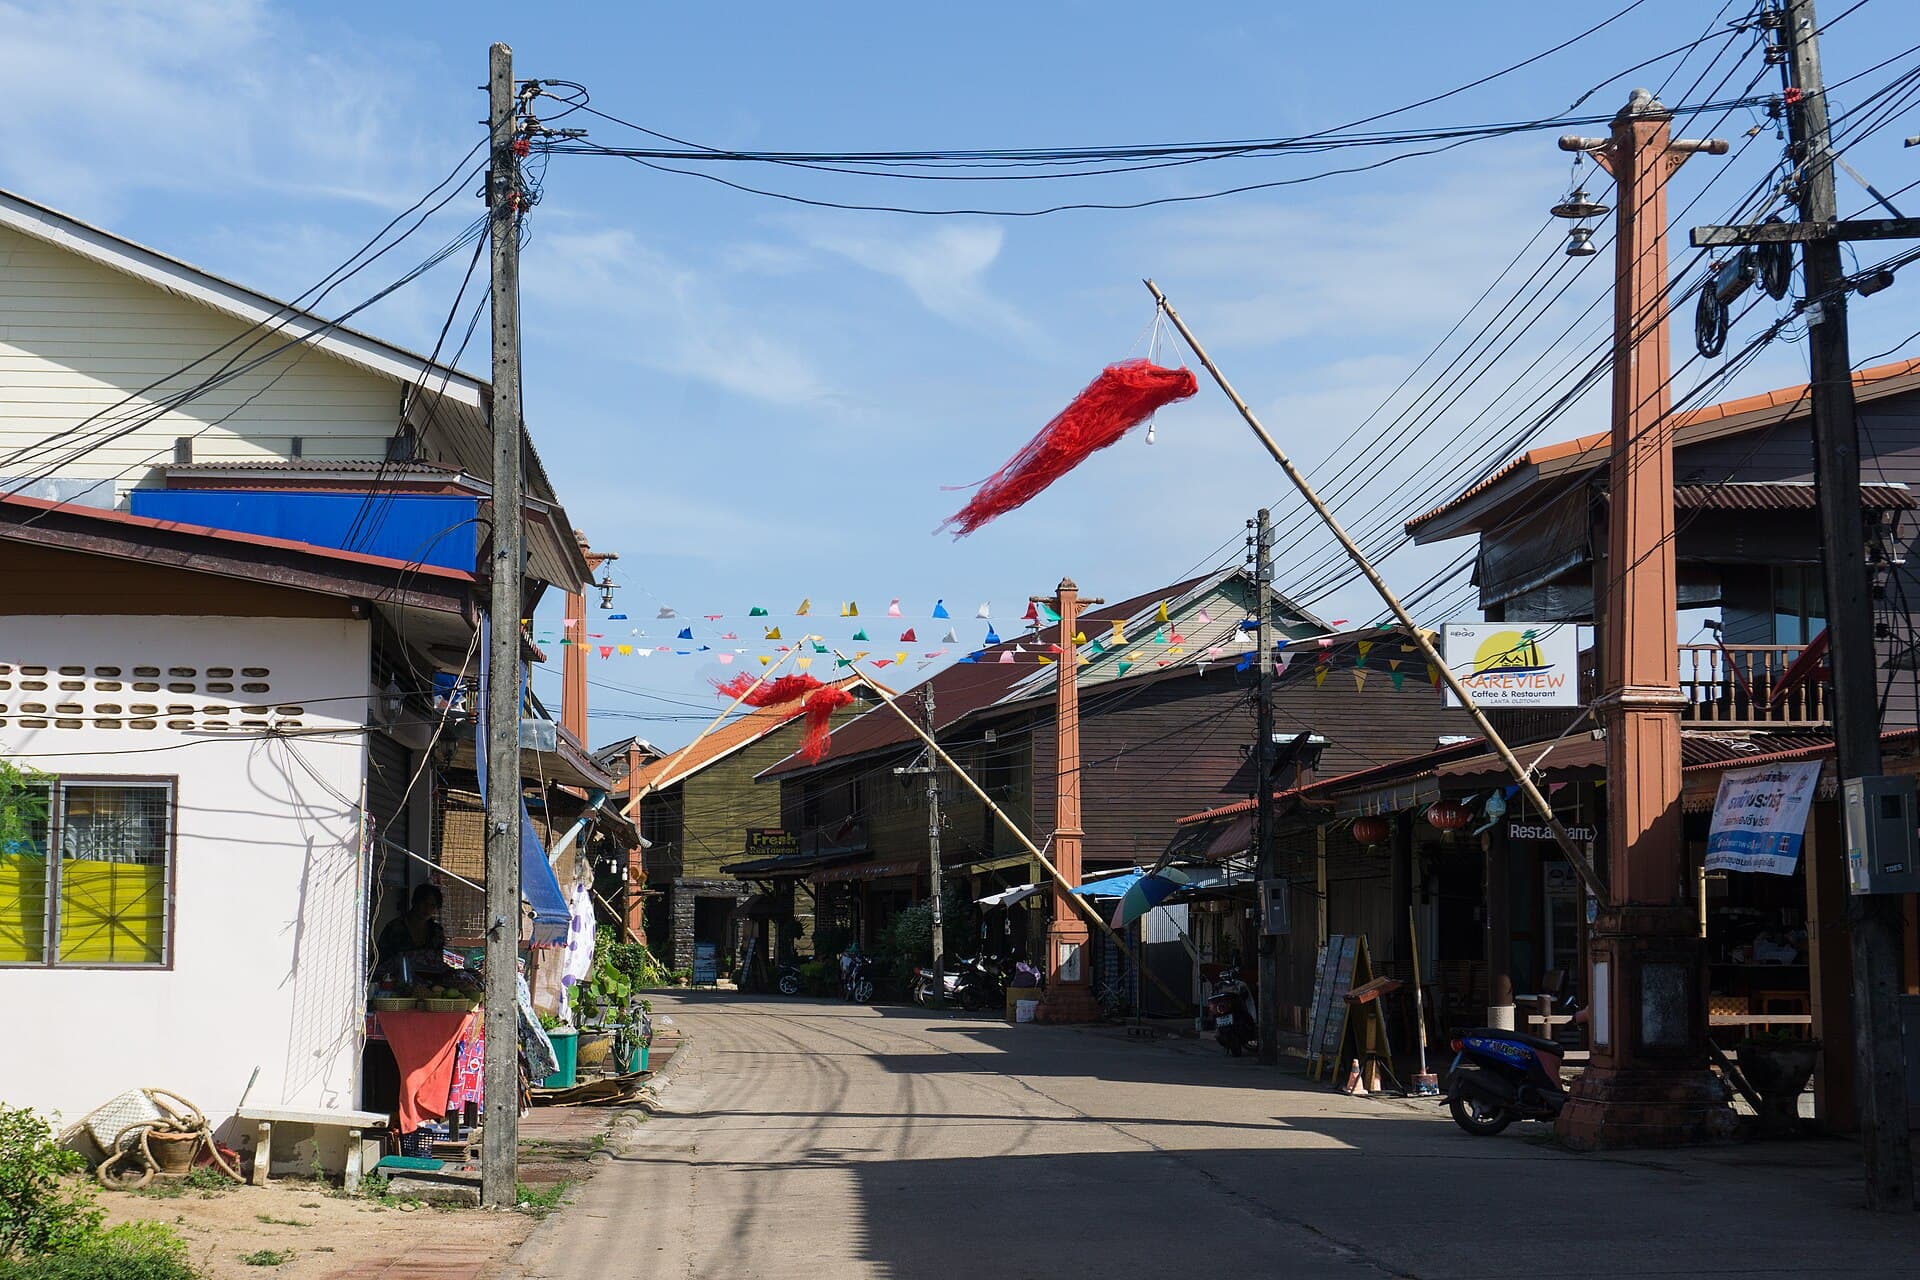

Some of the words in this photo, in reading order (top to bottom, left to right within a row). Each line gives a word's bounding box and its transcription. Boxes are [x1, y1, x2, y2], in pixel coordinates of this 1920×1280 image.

[1461, 673, 1565, 689] RAREVIEW
[1472, 690, 1499, 698] Coffee
[1501, 690, 1508, 698] &
[1511, 690, 1556, 698] Restaurant
[752, 831, 797, 845] Fresh
[1510, 824, 1593, 840] Restaant
[749, 846, 800, 854] Restaurant
